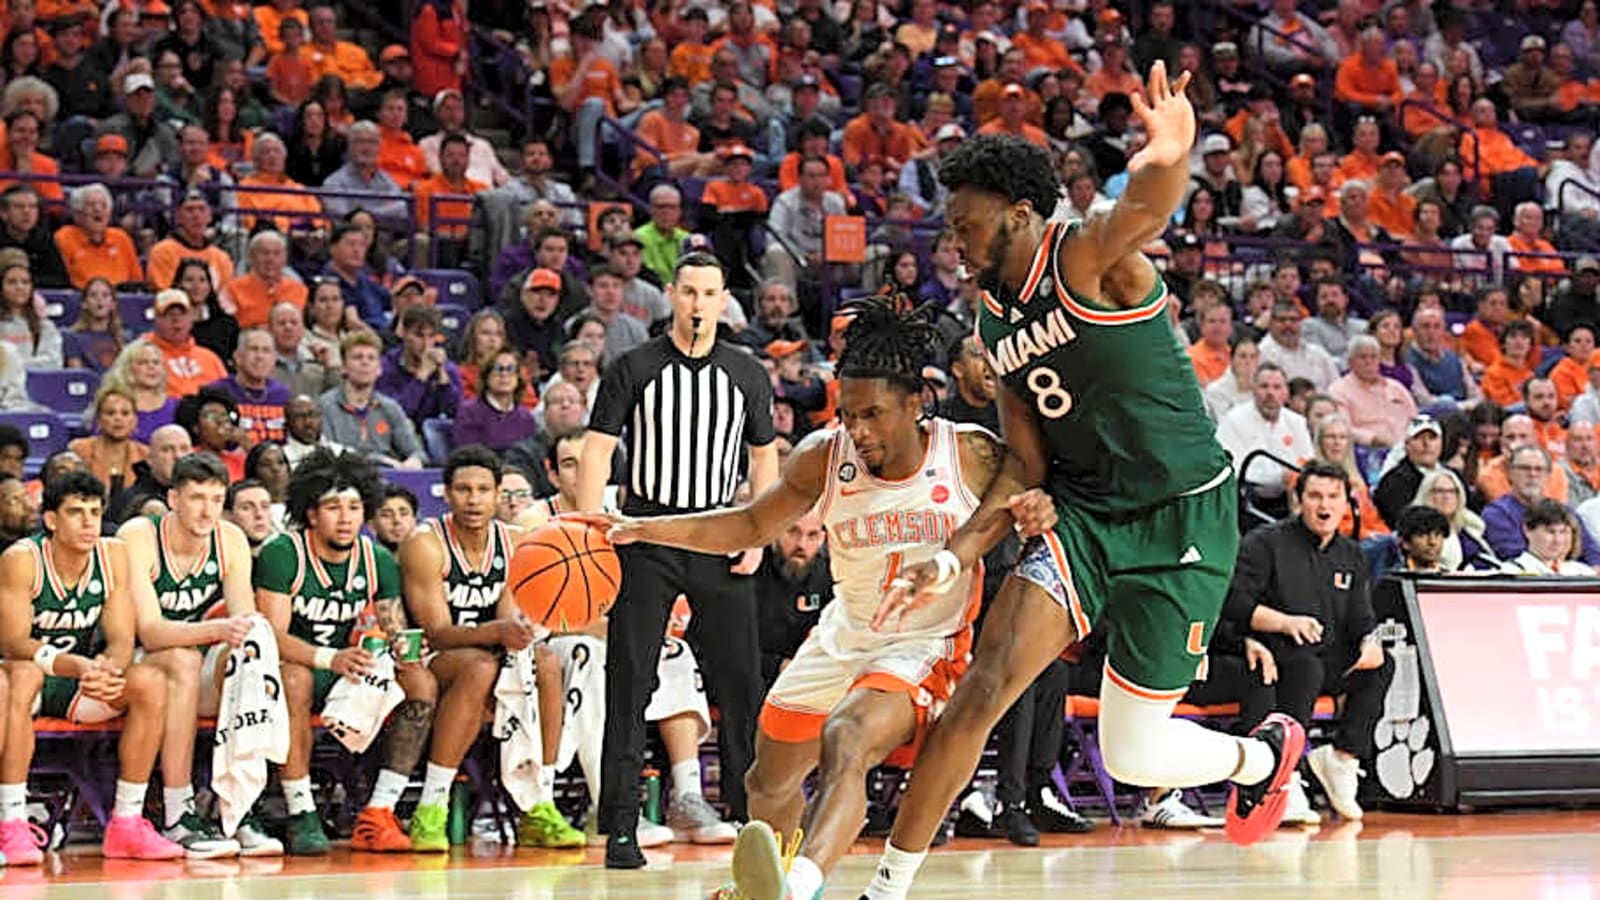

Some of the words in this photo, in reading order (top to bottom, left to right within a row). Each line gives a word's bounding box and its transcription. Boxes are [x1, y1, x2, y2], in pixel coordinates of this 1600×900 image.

[986, 307, 1078, 377] MIAMI
[1026, 366, 1073, 419] 8
[832, 508, 957, 549] CLEMSON
[881, 551, 902, 593] 1
